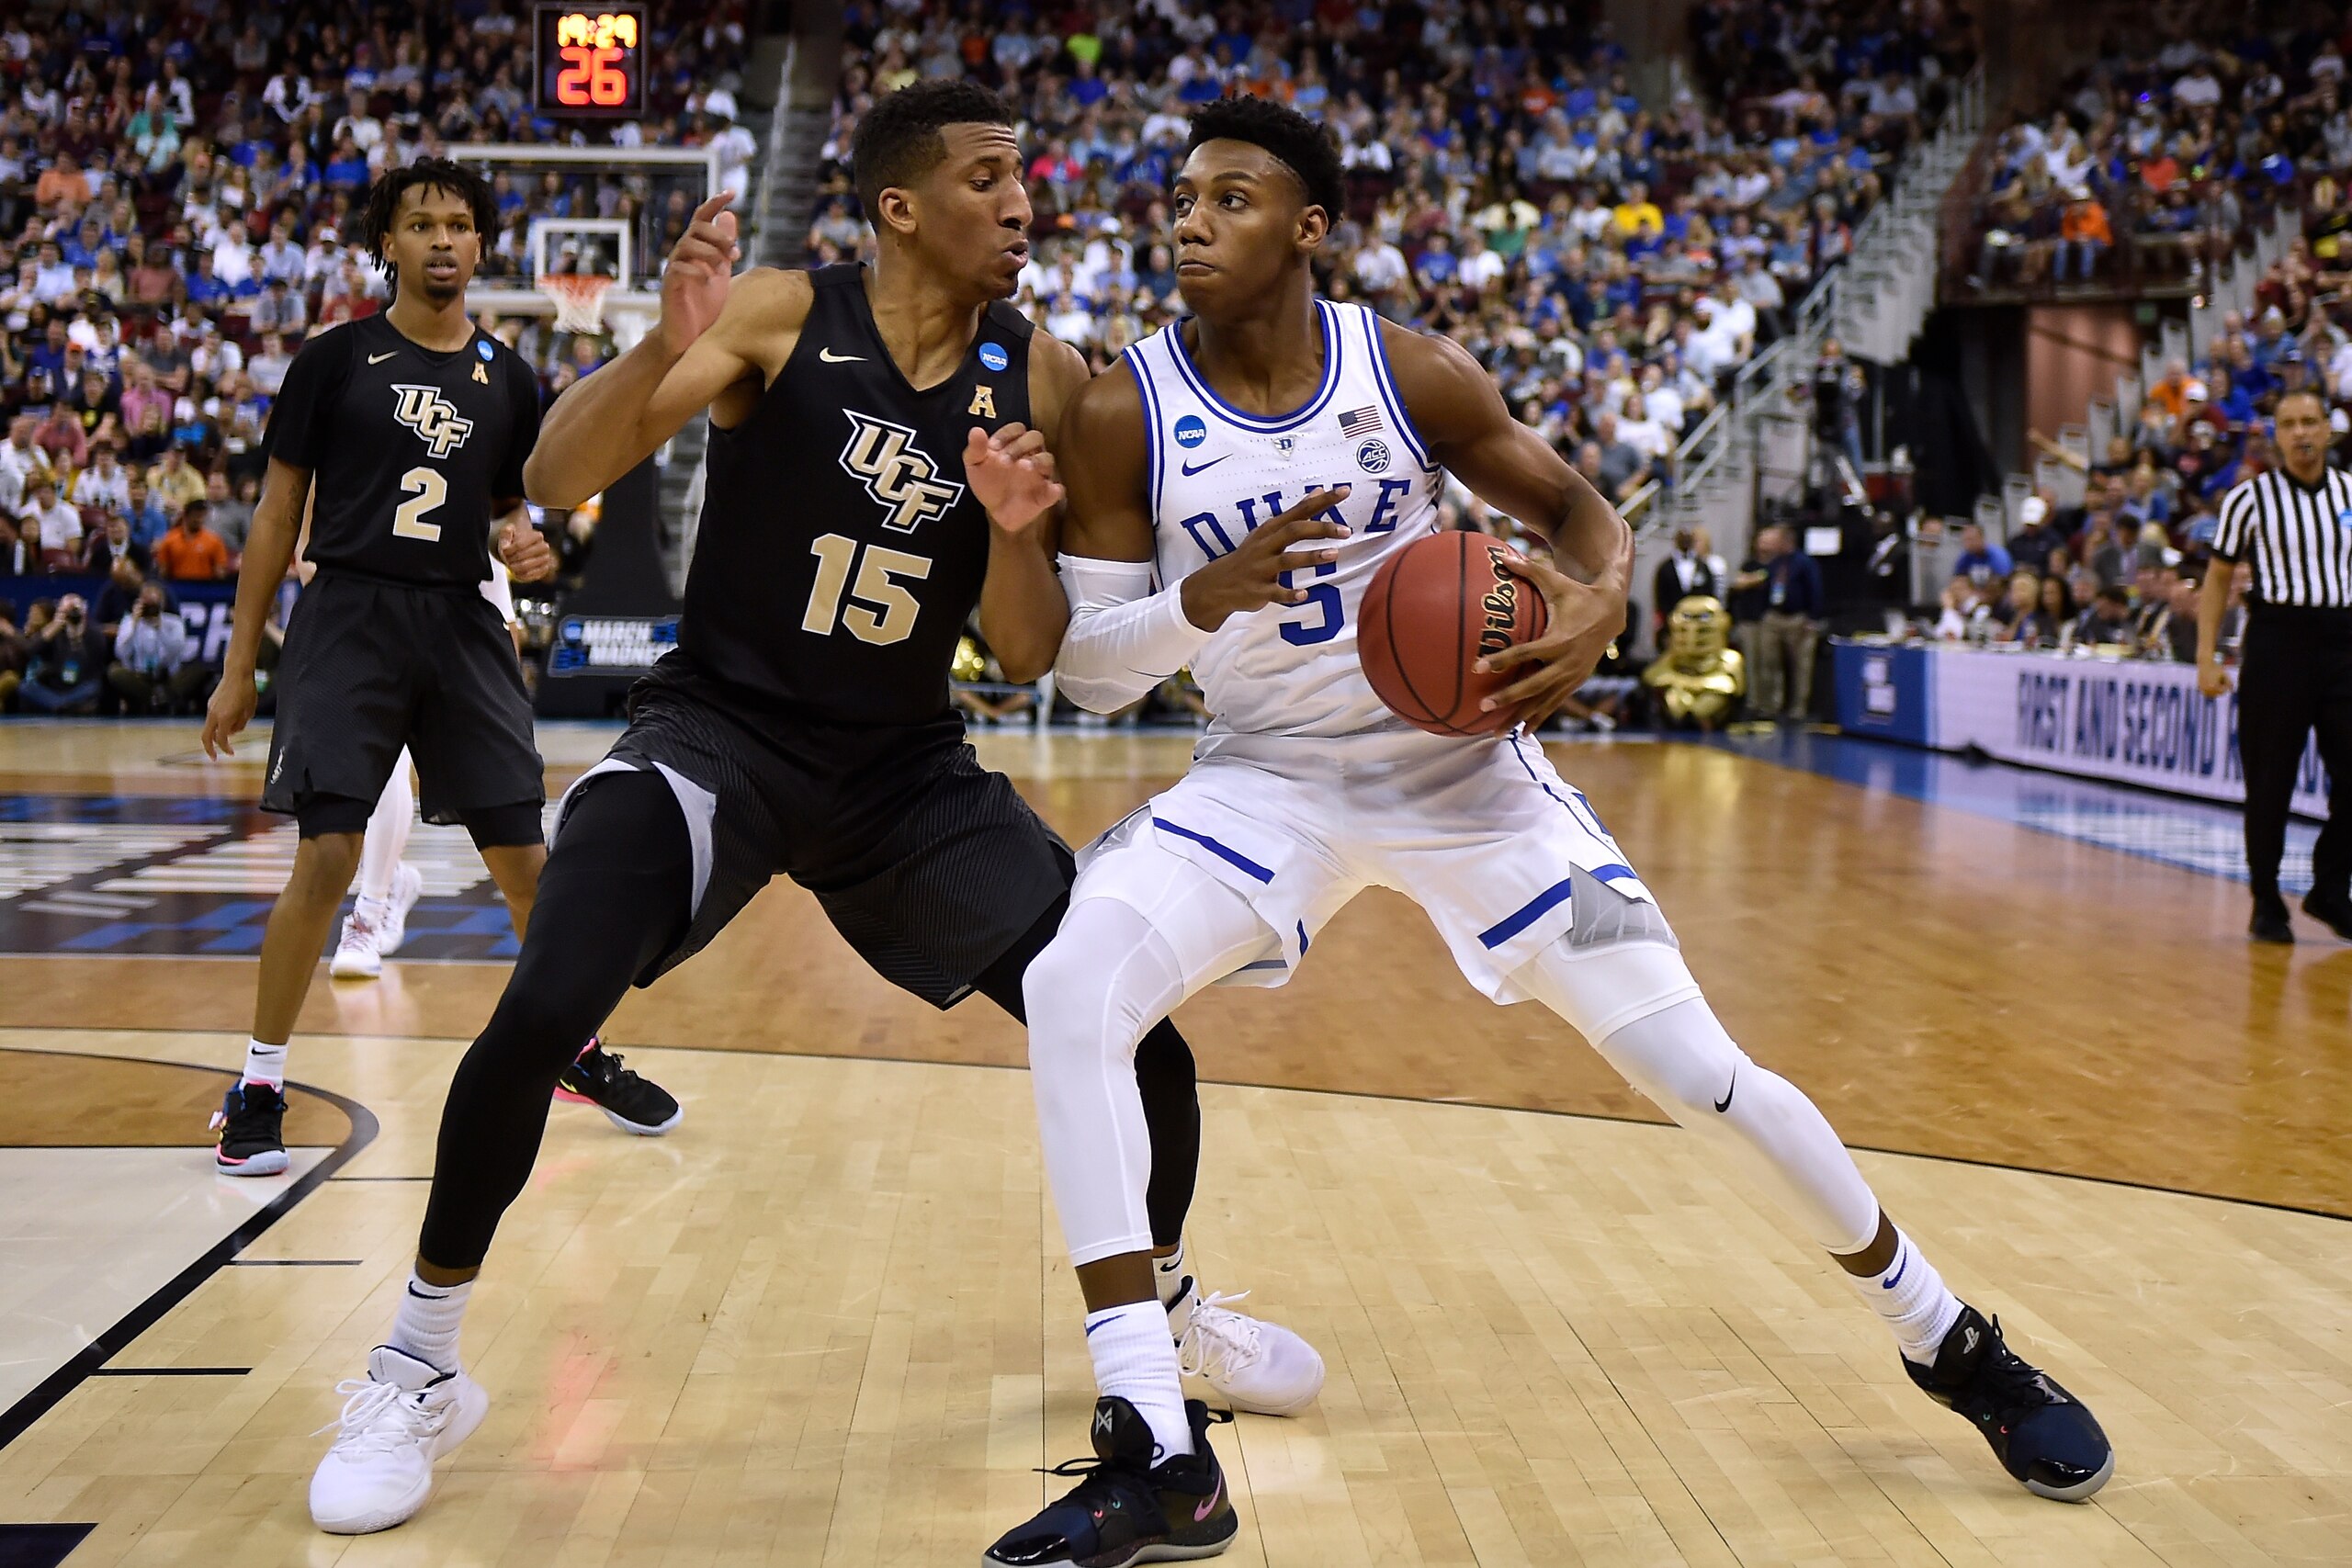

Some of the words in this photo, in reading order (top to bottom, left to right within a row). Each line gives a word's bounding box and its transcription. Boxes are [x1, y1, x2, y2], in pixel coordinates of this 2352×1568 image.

[557, 14, 638, 50] 19:29
[557, 46, 628, 106] 26
[471, 361, 489, 385] A
[982, 353, 1008, 367] NCAA
[393, 386, 471, 457] UCF
[967, 384, 997, 419] A
[1178, 428, 1205, 441] NCAA
[842, 413, 961, 532] UCF
[392, 467, 447, 542] 2
[801, 533, 933, 646] 15
[1278, 557, 1345, 647] 5
[582, 620, 650, 645] MARCH
[2017, 671, 2070, 752] FIRST
[2074, 674, 2120, 761] AND
[2123, 676, 2217, 776] SECOND
